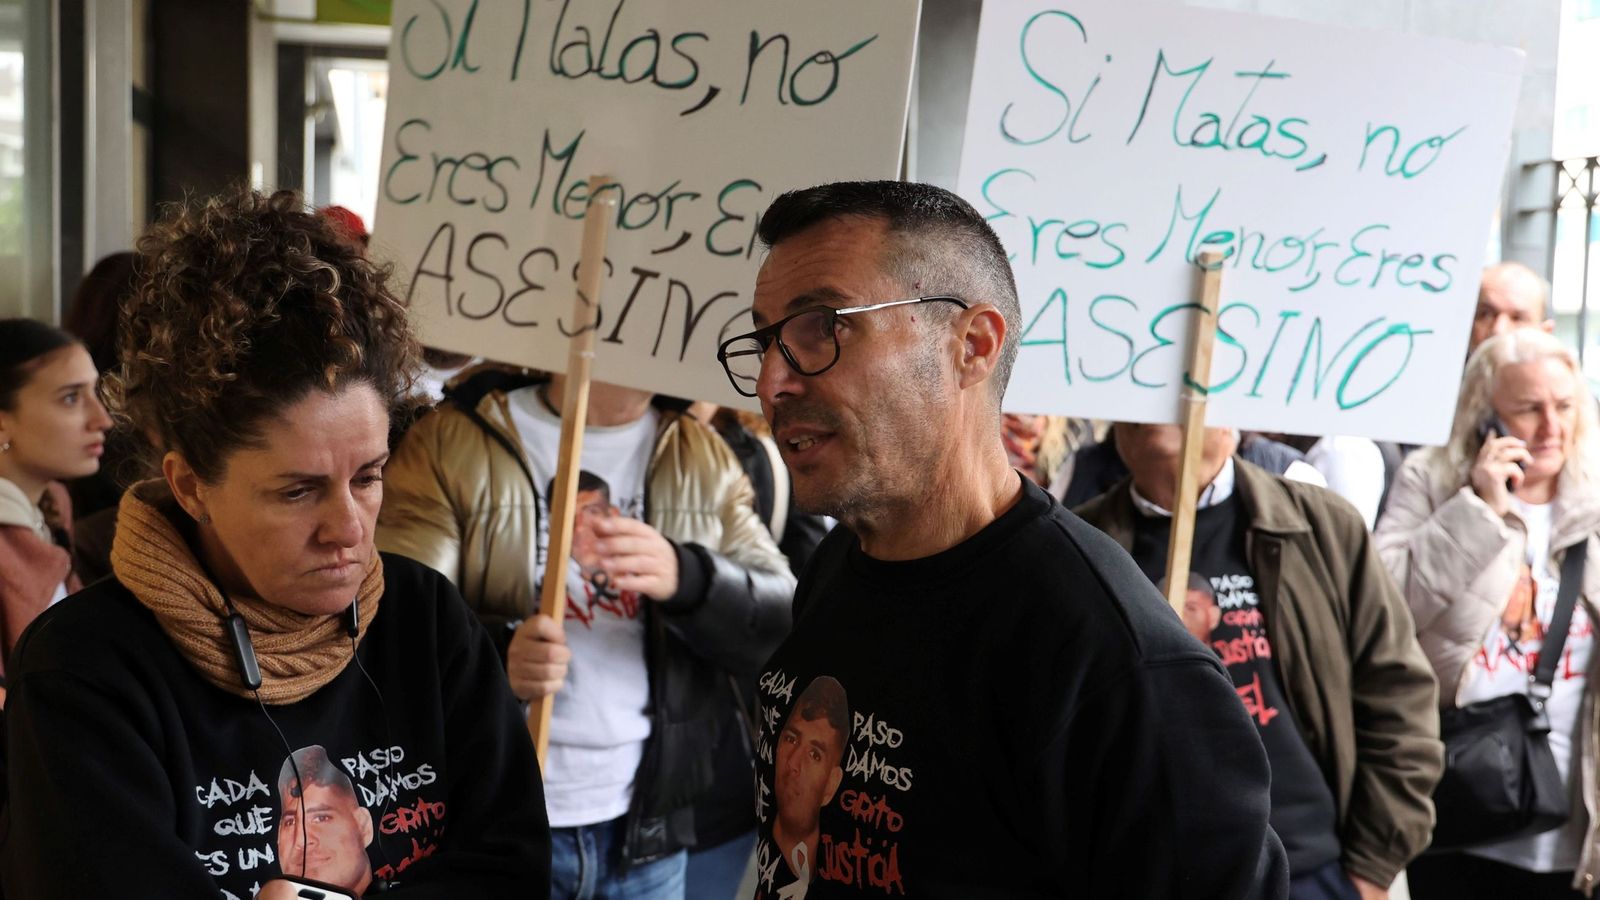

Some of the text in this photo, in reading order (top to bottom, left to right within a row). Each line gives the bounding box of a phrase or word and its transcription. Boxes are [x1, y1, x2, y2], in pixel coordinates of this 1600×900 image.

[740, 30, 879, 106] no
[1000, 9, 1470, 179] Si Matas, no
[385, 119, 521, 213] Eres
[530, 128, 702, 256] Menor,
[981, 167, 1459, 293] Eres Menor, Eres
[1020, 287, 1435, 411] ASESINO
[759, 668, 798, 704] CADA
[761, 705, 782, 735] UE
[853, 710, 904, 749] PASO
[340, 745, 405, 780] PASO
[845, 743, 914, 792] DAMOS
[195, 769, 271, 809] CADA
[356, 763, 437, 808] DAMOS
[213, 803, 273, 836] QUE
[237, 842, 275, 871] UN
